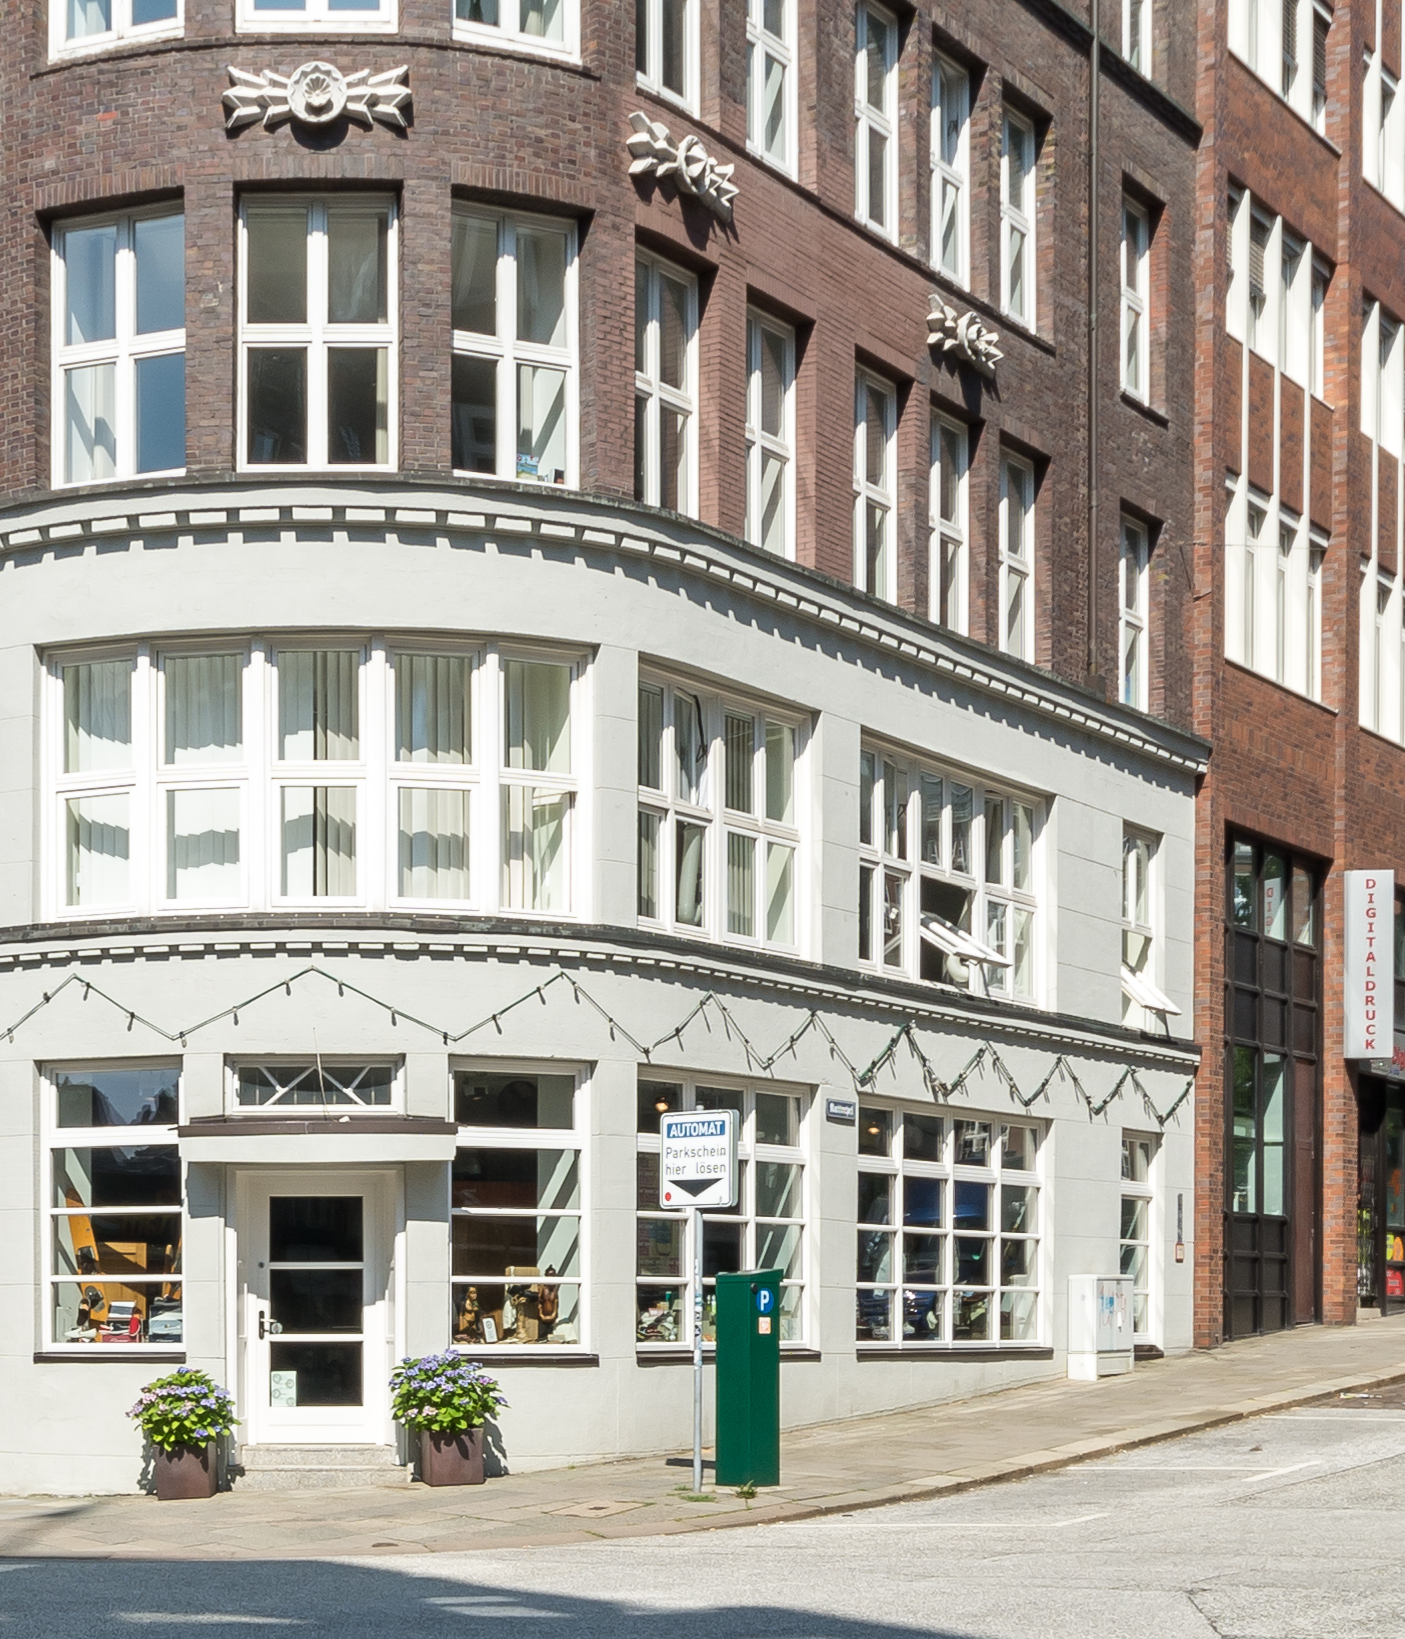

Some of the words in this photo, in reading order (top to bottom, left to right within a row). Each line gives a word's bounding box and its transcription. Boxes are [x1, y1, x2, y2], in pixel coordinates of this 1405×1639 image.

[1365, 878, 1376, 1050] DIGITALDRUCK
[669, 1121, 723, 1137] AUTOMAT
[665, 1144, 727, 1159] Parkschein
[665, 1163, 687, 1175] hier
[695, 1161, 727, 1174] lösen
[760, 1290, 770, 1311] P
